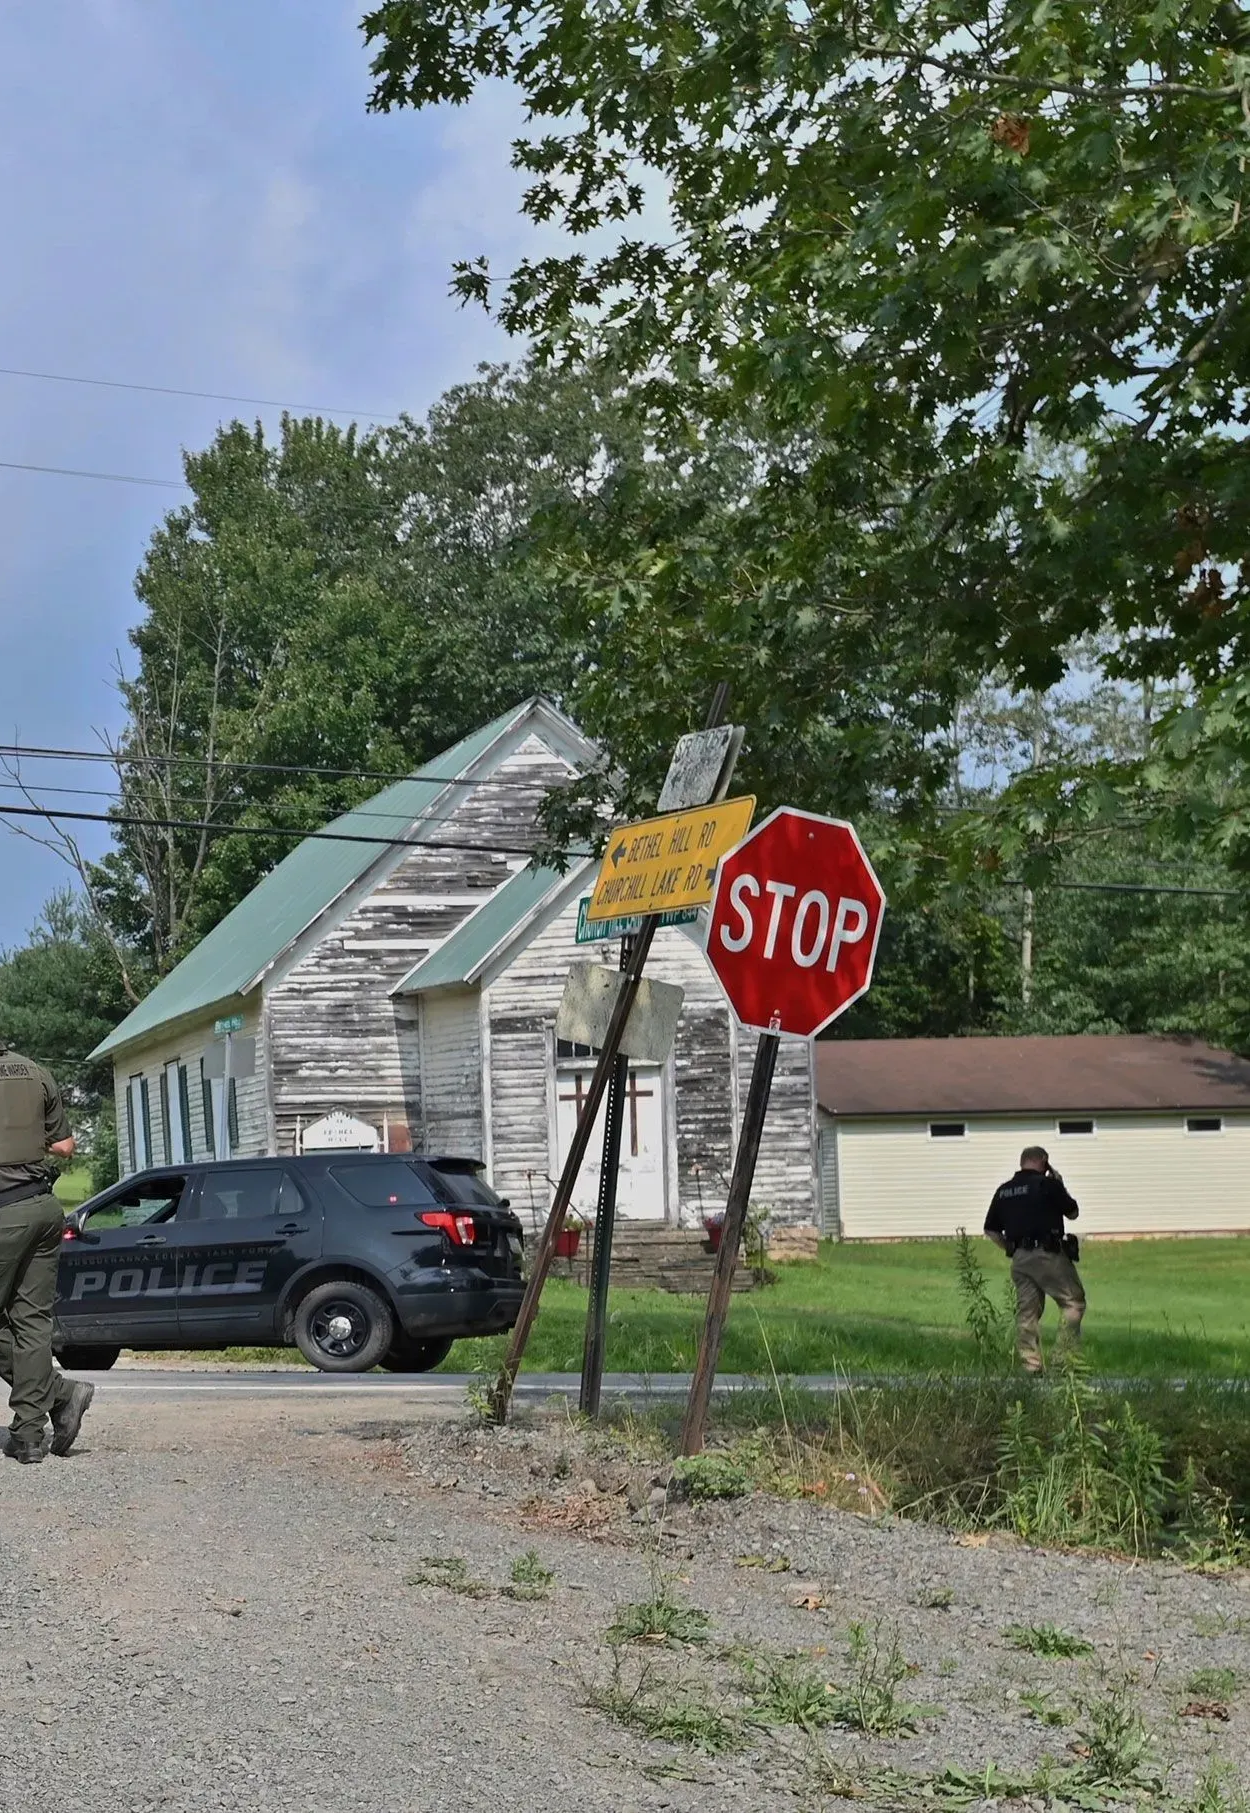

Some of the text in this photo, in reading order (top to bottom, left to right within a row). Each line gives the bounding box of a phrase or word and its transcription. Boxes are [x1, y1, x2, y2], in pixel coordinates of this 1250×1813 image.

[627, 821, 717, 863] BETHEL HILL RD
[596, 864, 703, 906] CHURCHILL LAKE RD
[720, 873, 869, 973] STOP
[999, 1185, 1030, 1199] POLICE
[70, 1260, 268, 1301] POLICE
